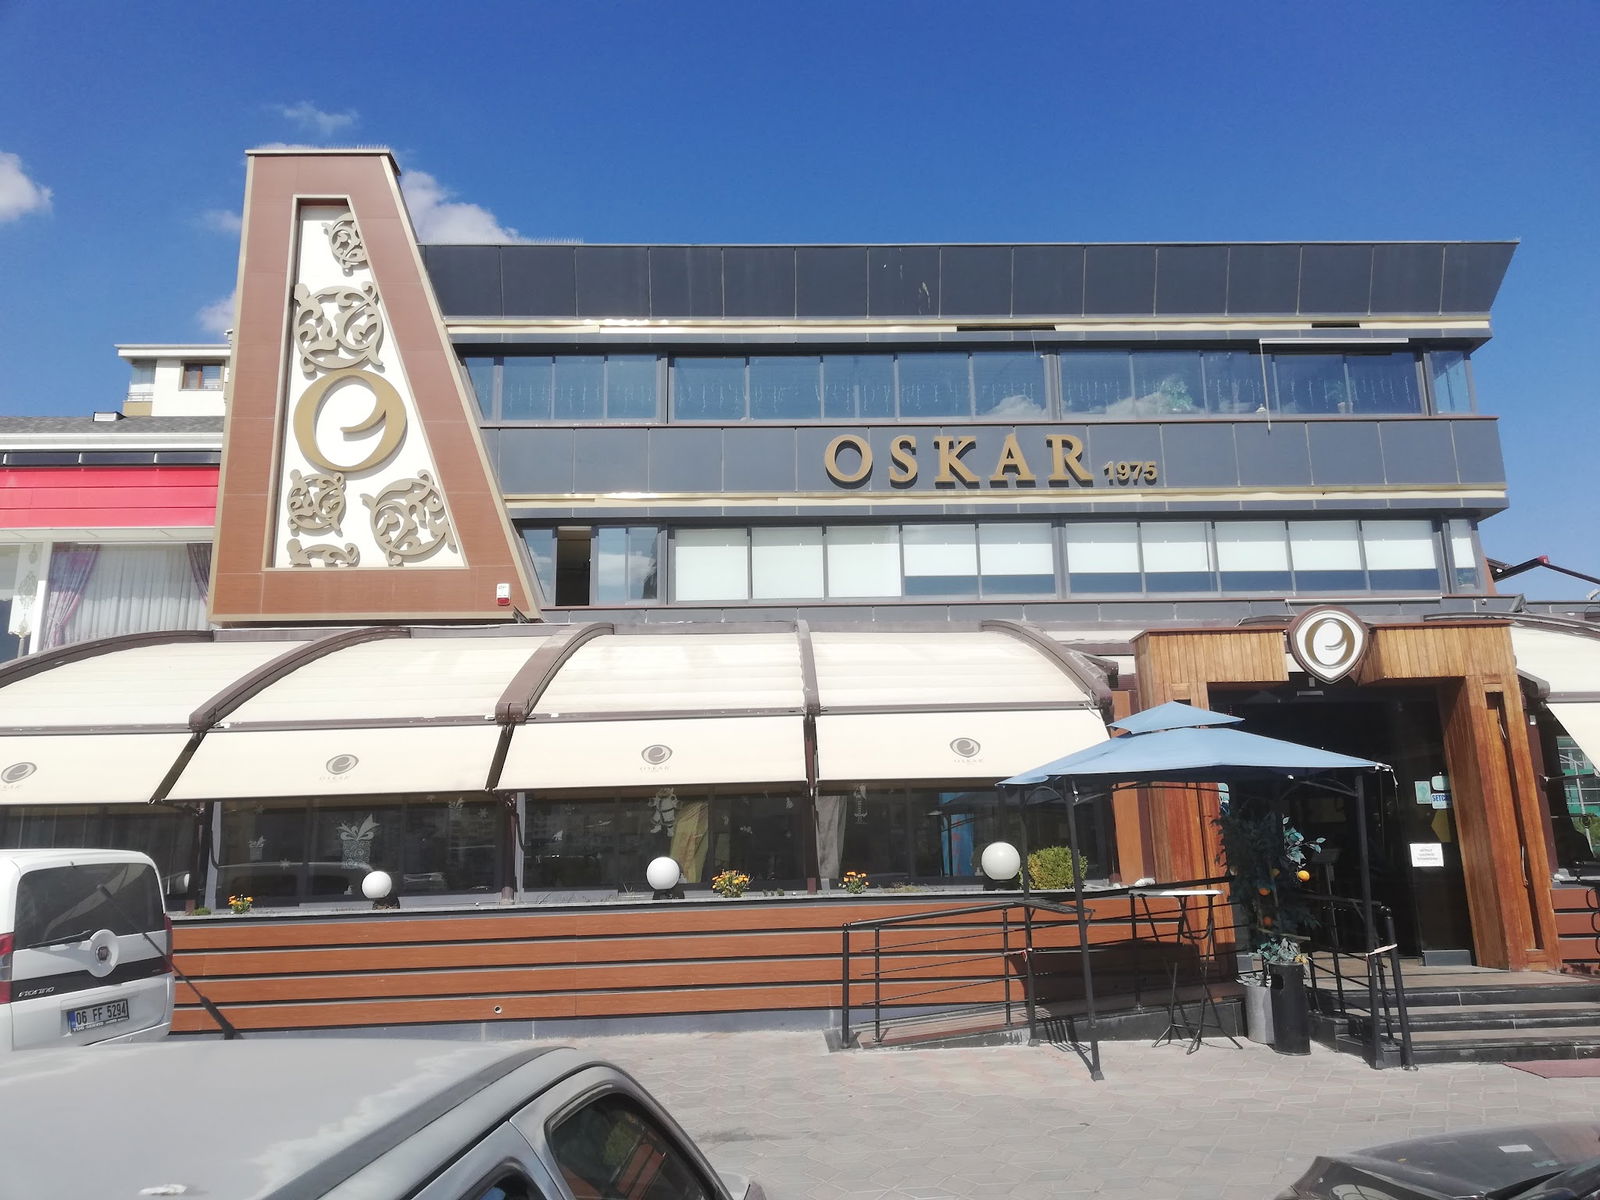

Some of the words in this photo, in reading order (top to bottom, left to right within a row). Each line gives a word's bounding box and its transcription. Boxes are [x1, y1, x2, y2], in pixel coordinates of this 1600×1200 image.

[824, 434, 1094, 487] OSKAR
[1104, 461, 1157, 485] 1975
[76, 1011, 87, 1026] 06
[93, 1008, 102, 1021] FF
[107, 1002, 127, 1018] 5294
